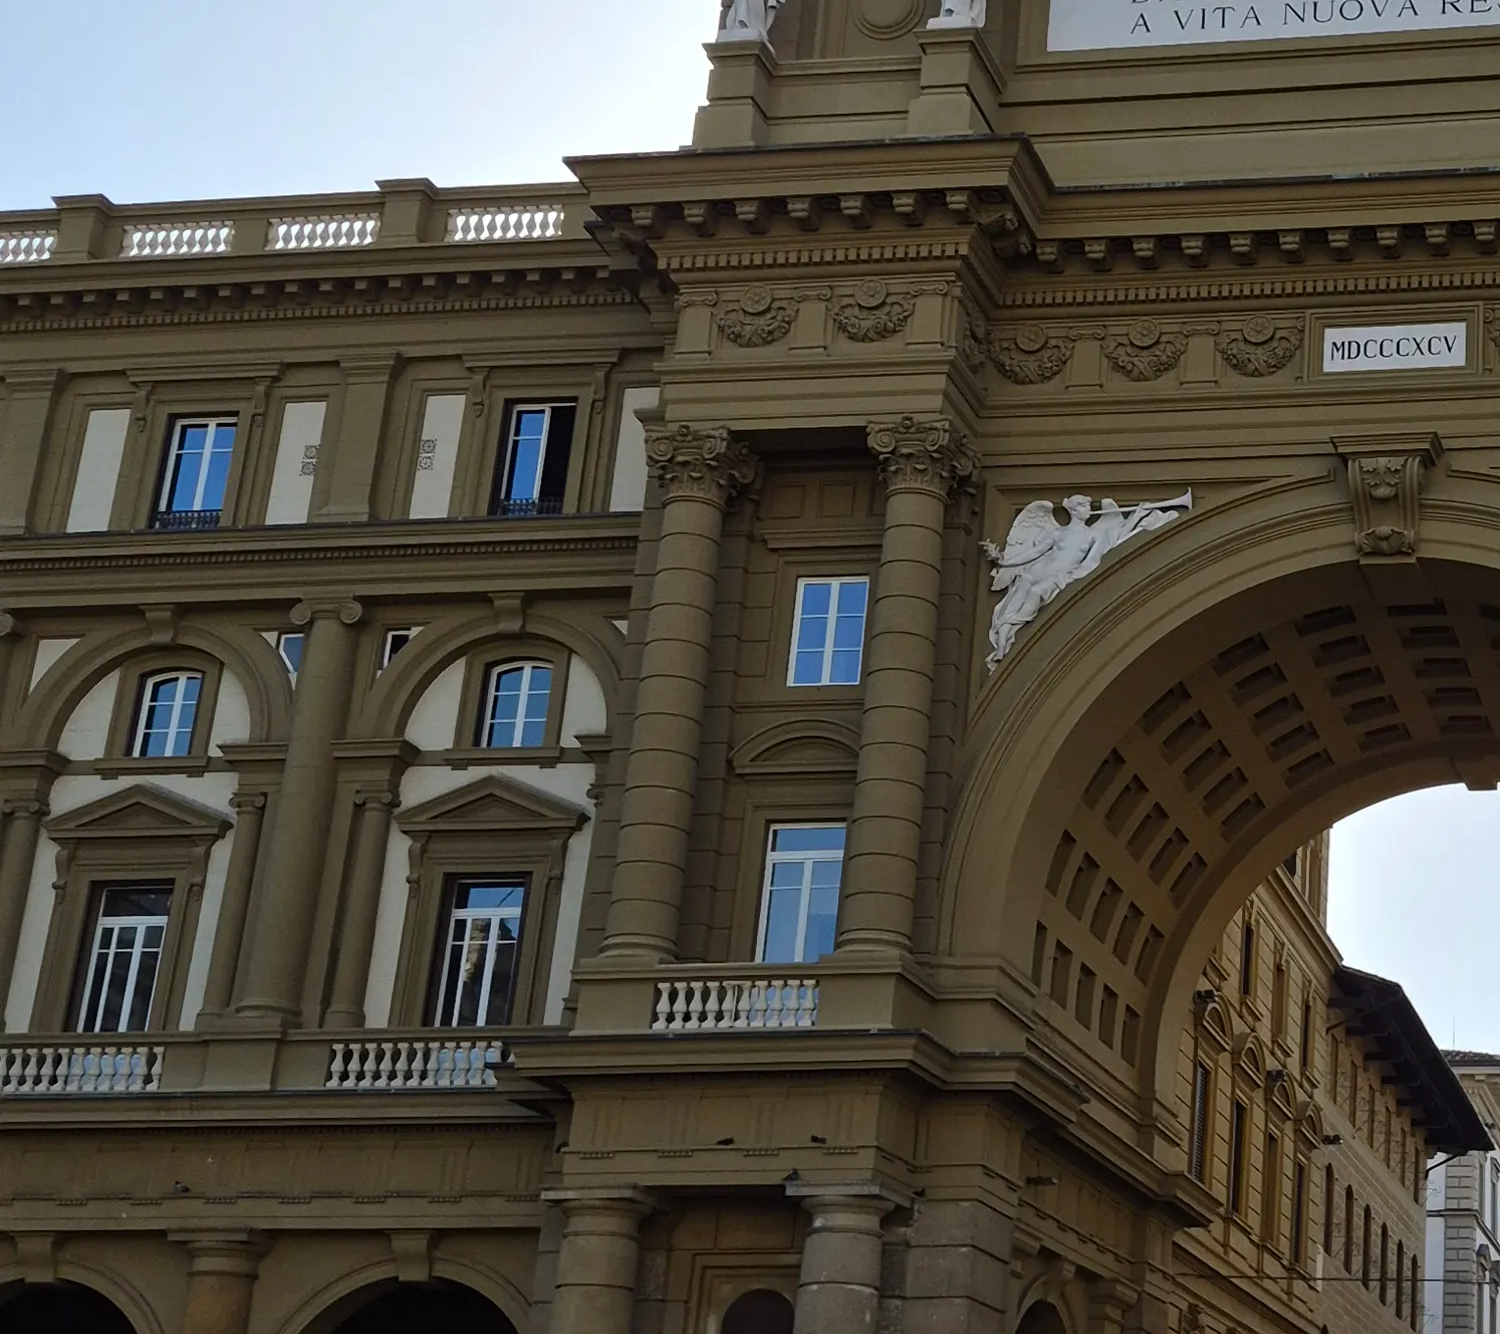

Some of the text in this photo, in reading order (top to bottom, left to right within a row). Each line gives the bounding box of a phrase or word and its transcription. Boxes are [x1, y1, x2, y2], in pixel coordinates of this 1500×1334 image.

[1130, 12, 1152, 35] A
[1173, 5, 1262, 31] VITA
[1330, 334, 1458, 361] MDCCCXCV
